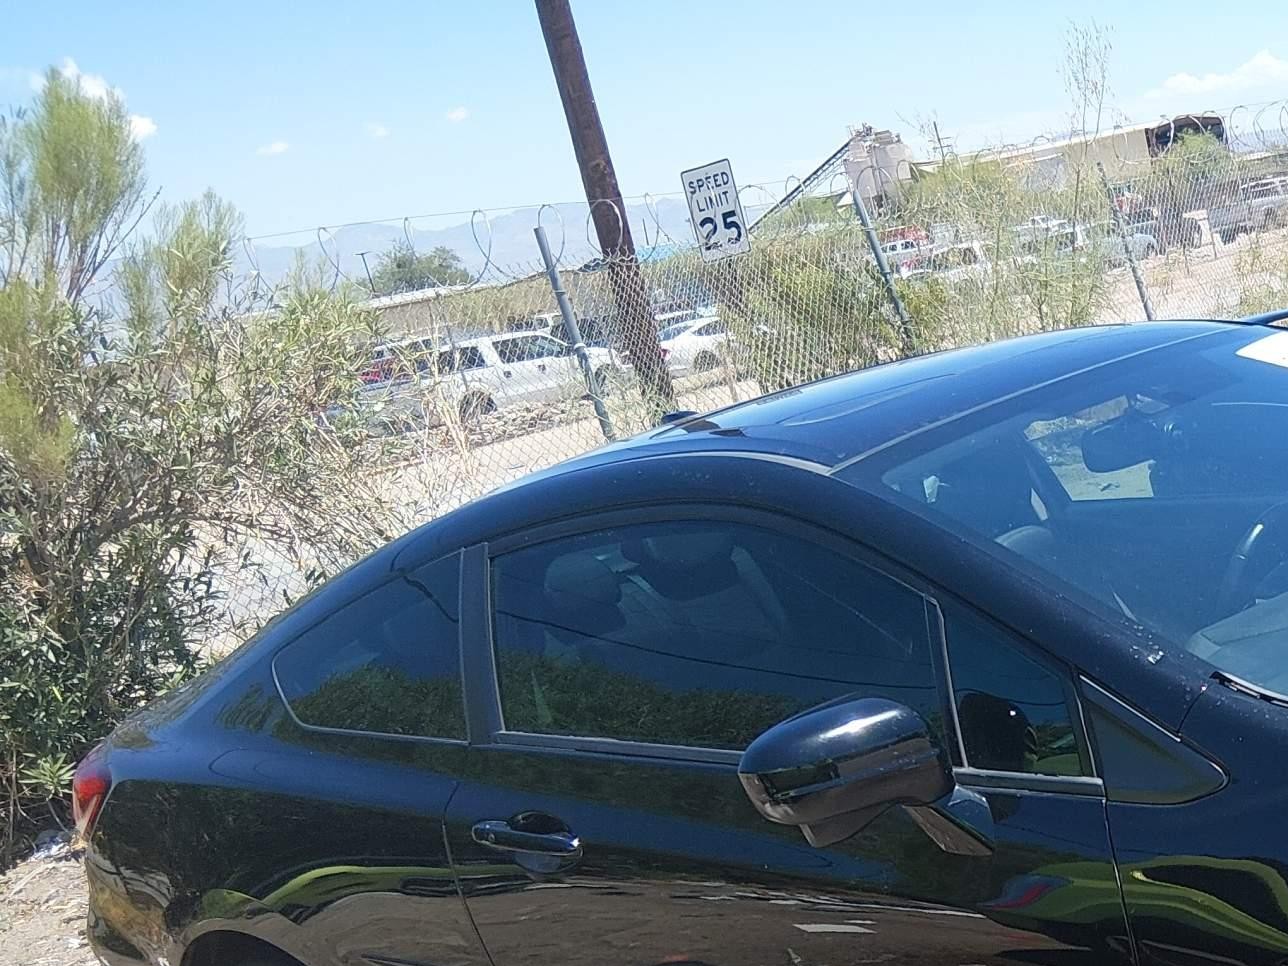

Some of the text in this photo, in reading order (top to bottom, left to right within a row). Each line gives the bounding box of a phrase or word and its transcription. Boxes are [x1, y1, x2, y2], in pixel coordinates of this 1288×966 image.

[688, 171, 730, 195] SPEED
[696, 190, 730, 213] LIMIT
[699, 209, 742, 251] 25
